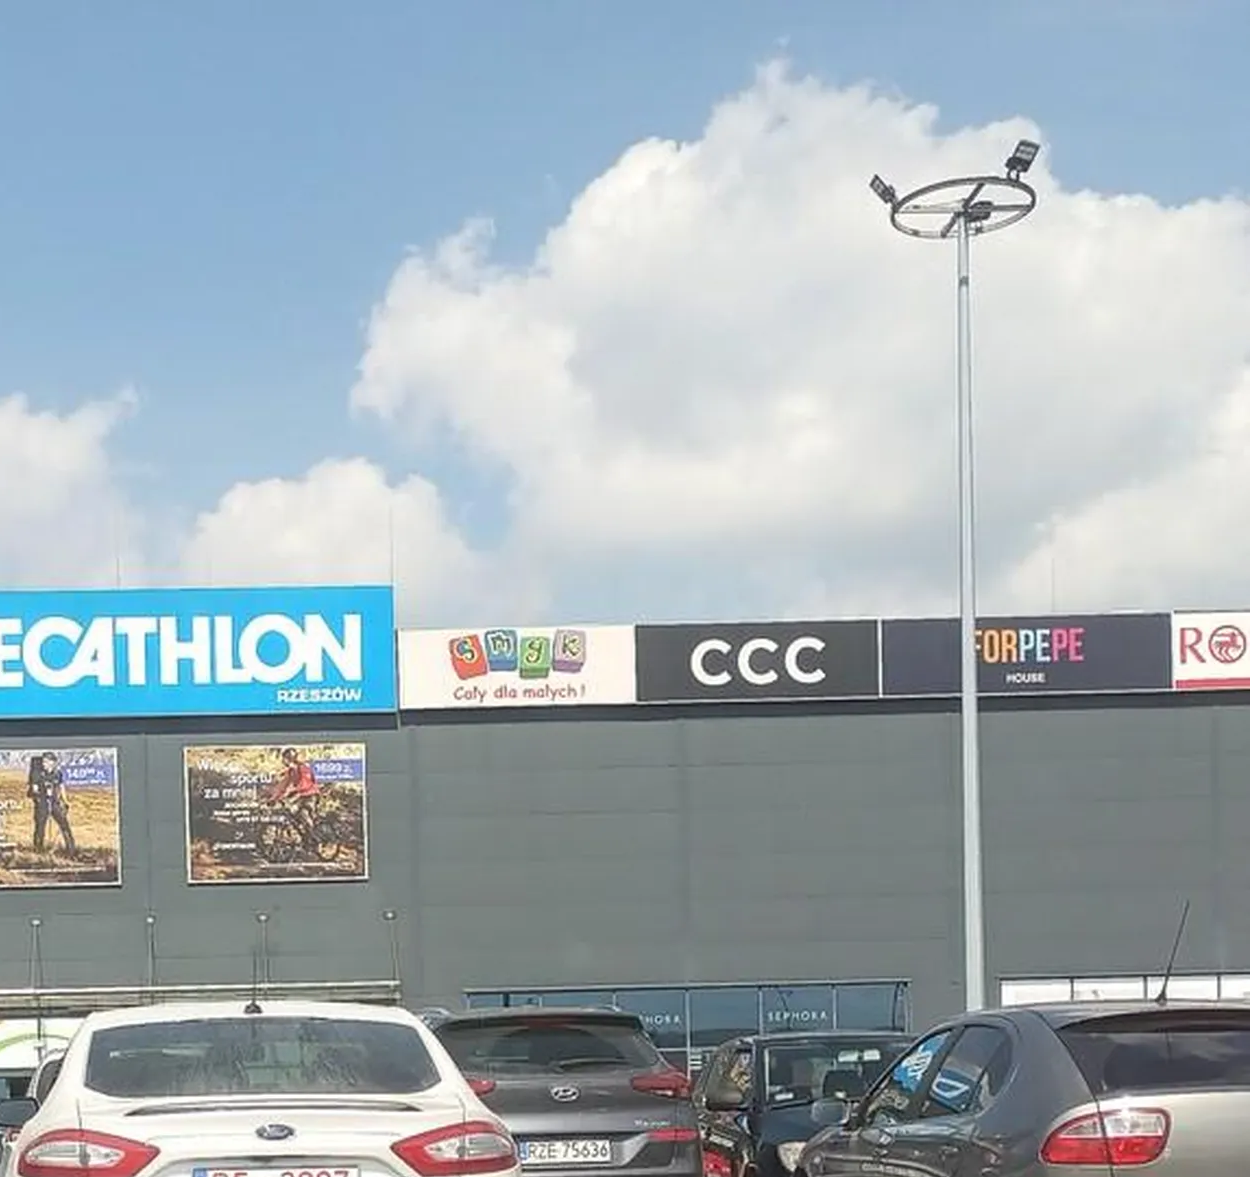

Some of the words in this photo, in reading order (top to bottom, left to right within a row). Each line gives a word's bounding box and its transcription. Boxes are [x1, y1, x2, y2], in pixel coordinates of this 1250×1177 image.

[690, 637, 826, 685] CCC
[1005, 672, 1047, 683] HOUSE
[277, 688, 362, 703] RZESZÓW
[768, 1010, 828, 1023] SEPHORA
[528, 1143, 557, 1159] RZE
[561, 1141, 608, 1158] 75636
